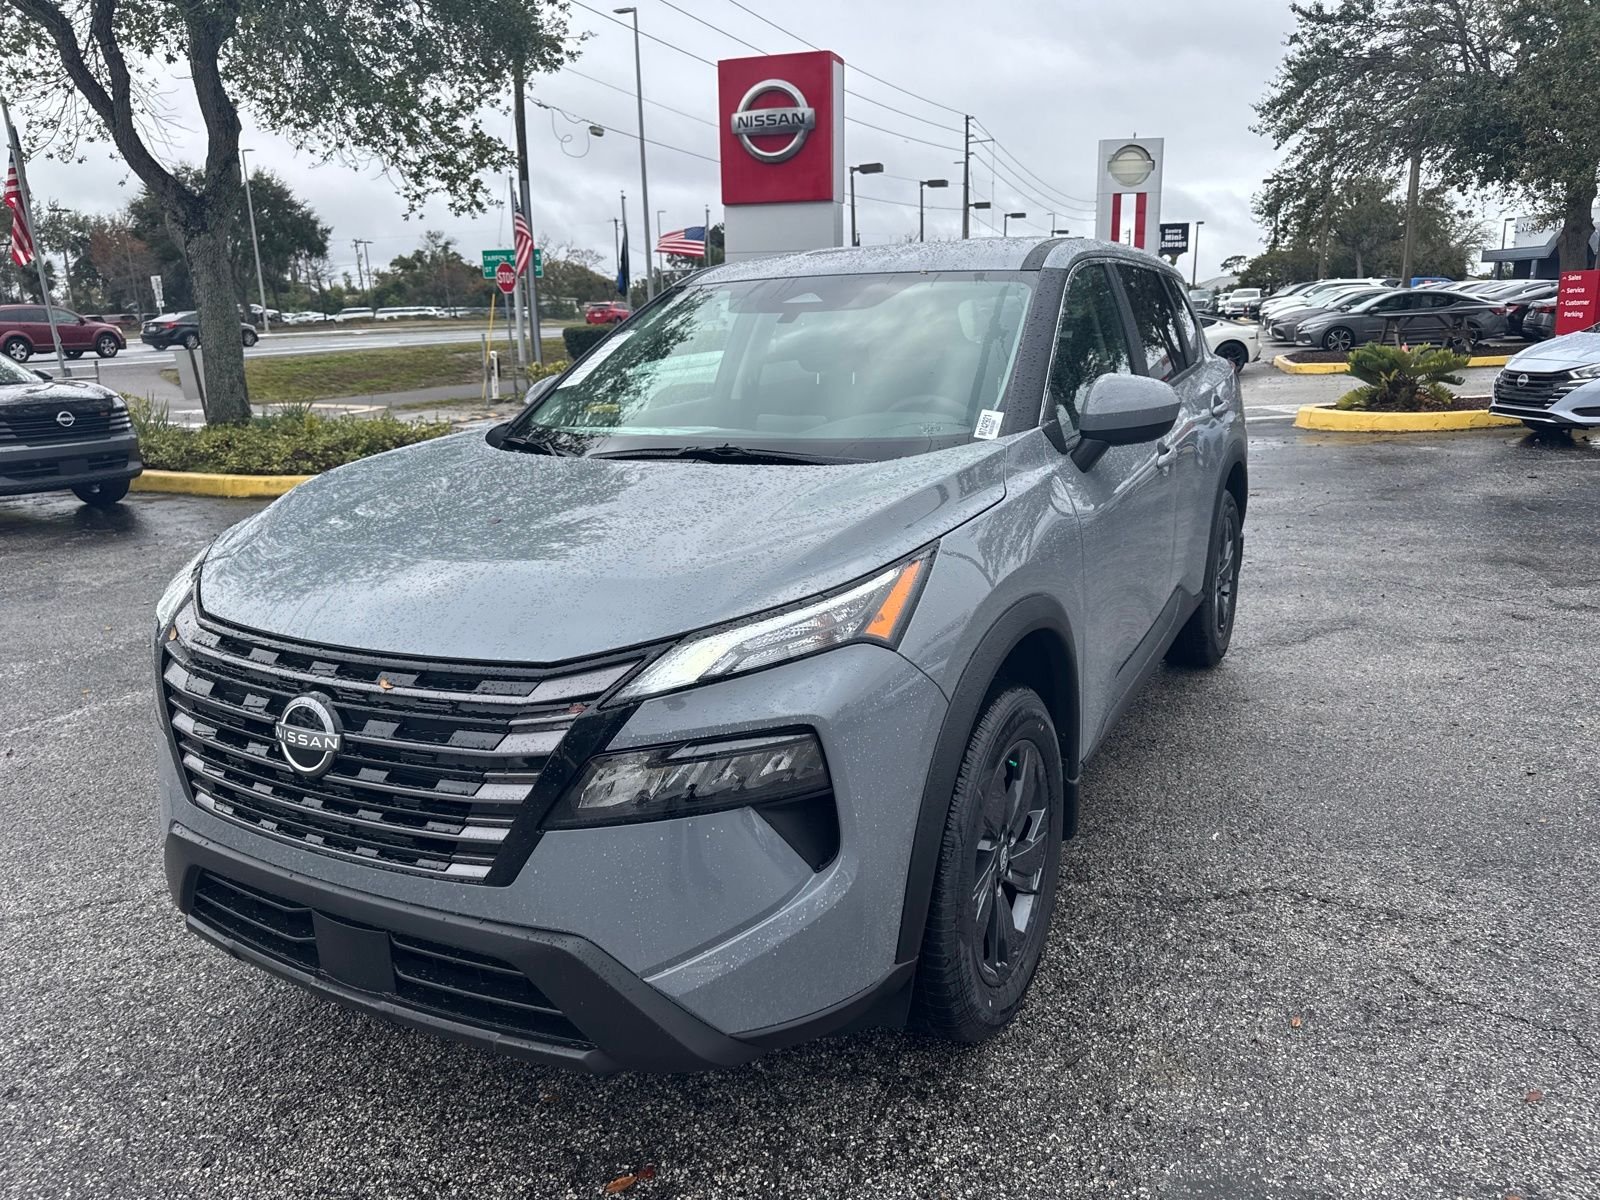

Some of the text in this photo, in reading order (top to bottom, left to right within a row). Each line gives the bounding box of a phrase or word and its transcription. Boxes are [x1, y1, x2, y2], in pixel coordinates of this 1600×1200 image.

[737, 112, 806, 129] NISSAN
[498, 272, 515, 283] STOP
[275, 725, 338, 749] NISSAN
